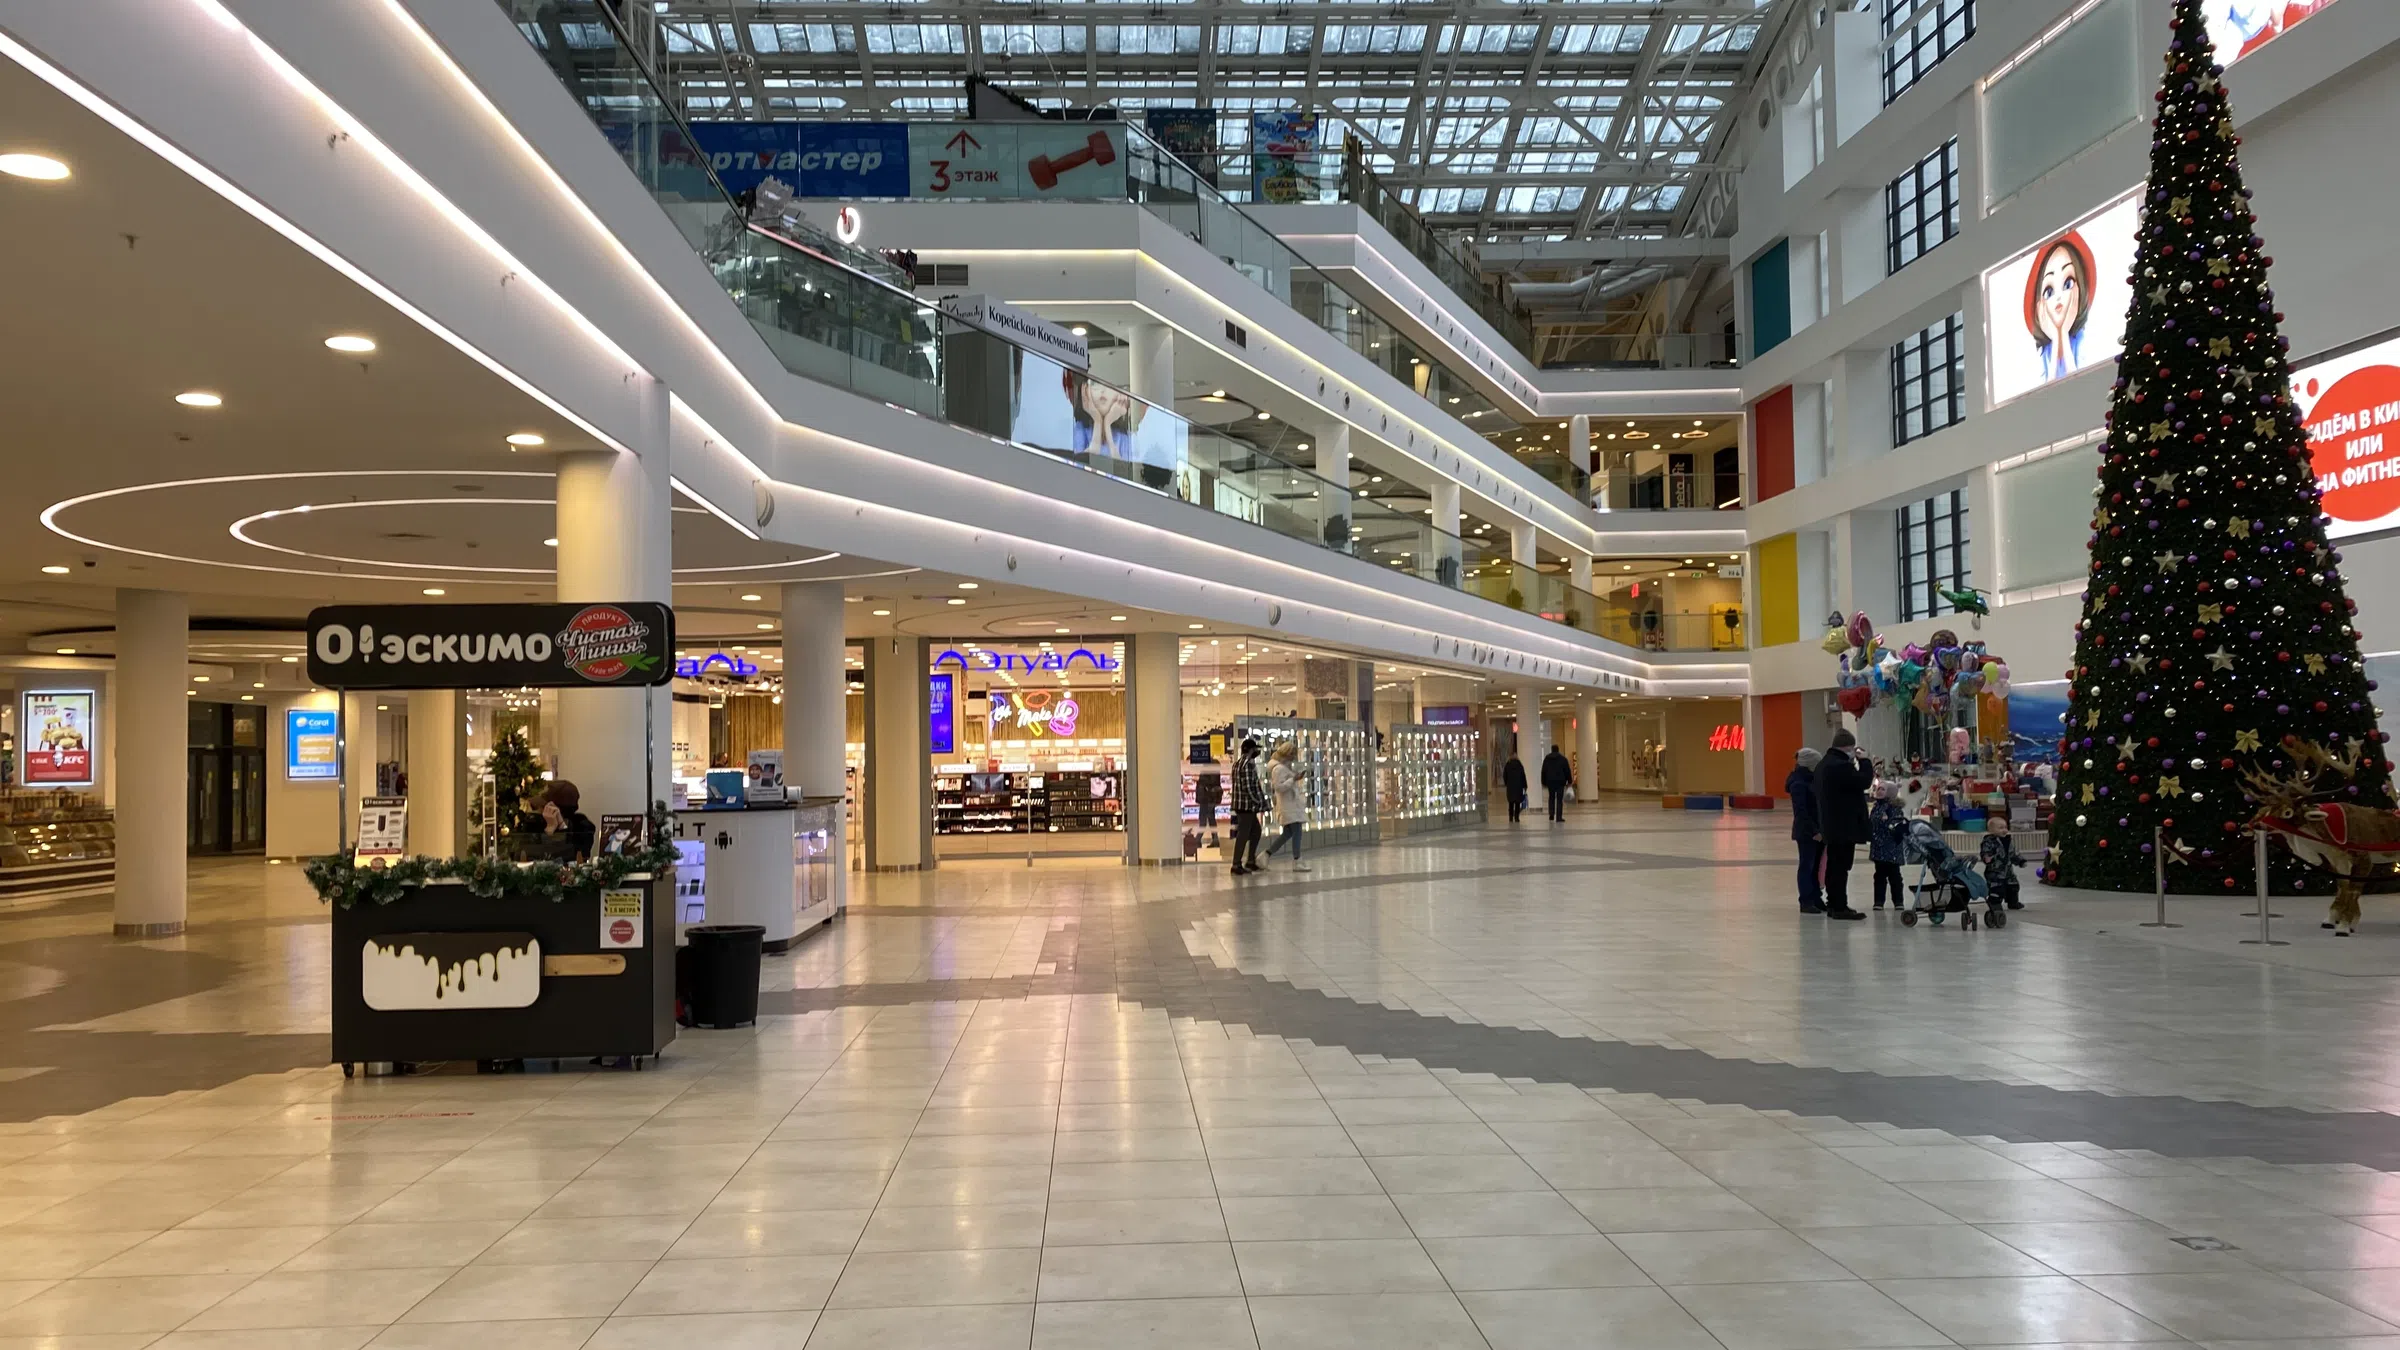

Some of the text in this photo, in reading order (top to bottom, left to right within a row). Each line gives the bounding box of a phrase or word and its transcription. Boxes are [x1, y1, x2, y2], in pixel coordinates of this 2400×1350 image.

[929, 160, 999, 192] 3 этаж
[988, 305, 1086, 357] Корейская Косметика
[2359, 408, 2371, 430] В
[2374, 400, 2400, 426] КИ
[2346, 432, 2384, 460] ИЛИ
[2316, 471, 2339, 493] НА
[581, 611, 623, 626] ПРОДУКТ
[556, 622, 649, 648] Чистая
[564, 639, 647, 667] Линия
[308, 719, 329, 727] Coral
[1709, 724, 1746, 751] H&M
[63, 755, 85, 764] KFC
